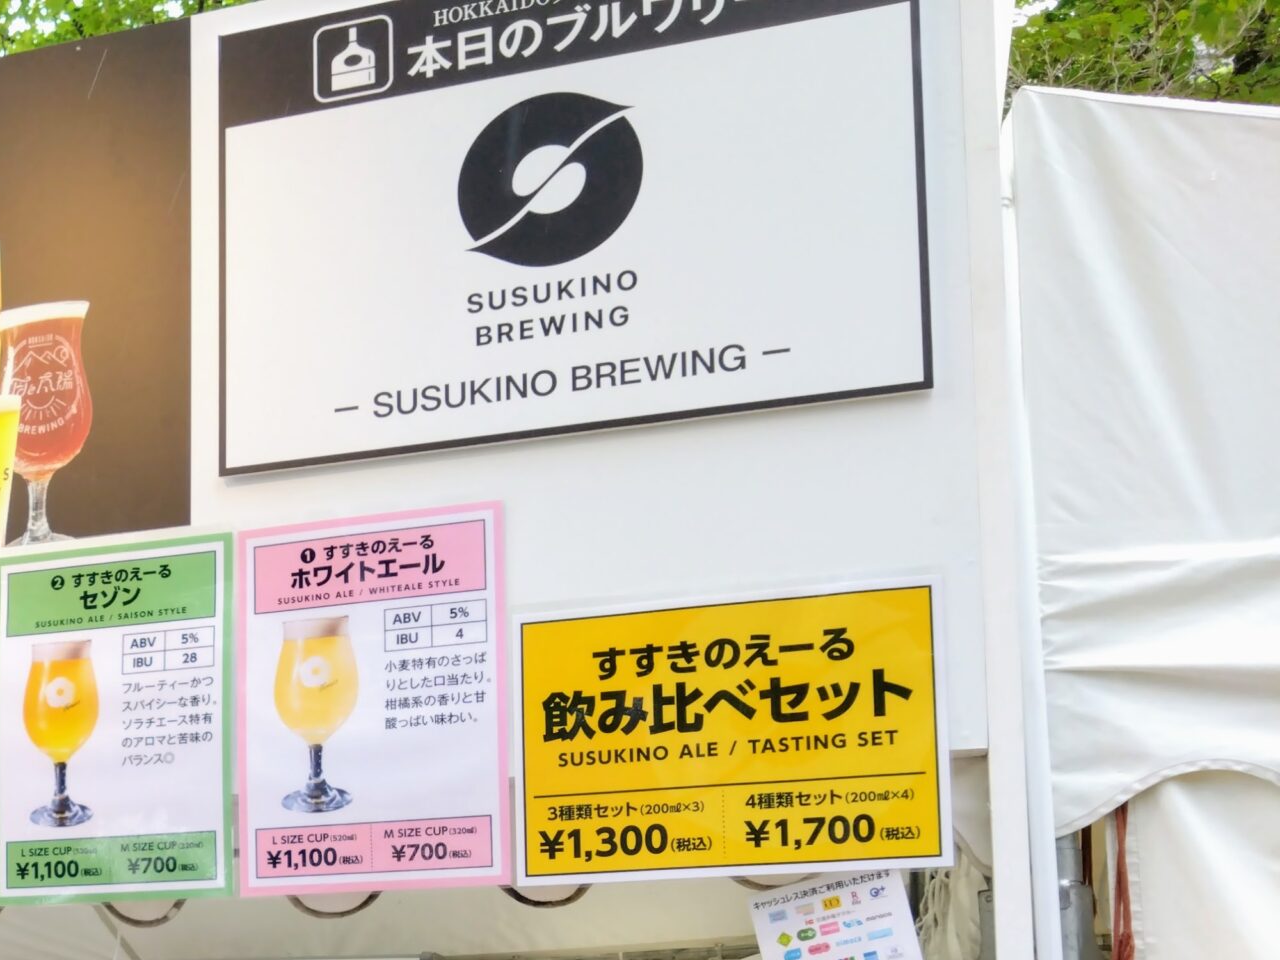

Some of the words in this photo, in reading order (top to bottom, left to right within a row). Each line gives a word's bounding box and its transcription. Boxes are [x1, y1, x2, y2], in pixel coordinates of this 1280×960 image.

[407, 0, 756, 79] 本日のブルワリ
[465, 268, 639, 315] SUSUKINO
[474, 305, 630, 347] BREWING
[371, 369, 557, 419] SUSUKINO
[571, 343, 746, 392] BREWING
[324, 535, 434, 560] すすきのえーる
[72, 564, 171, 587] すすきのえーる
[291, 553, 445, 589] ホワイトエール
[79, 586, 140, 611] セゾン
[278, 593, 330, 605] SUSUKINO
[335, 589, 354, 598] ALE
[368, 583, 423, 595] WHITEALE
[428, 578, 460, 588] STYLE
[35, 617, 83, 628] SUSUKINO
[88, 614, 105, 623] ALE
[118, 609, 153, 620] SAISON
[158, 606, 187, 616] STYLE
[392, 612, 421, 625] ABV
[449, 607, 469, 619] 5%
[130, 637, 156, 649] ABV
[181, 633, 199, 644] 5%
[396, 633, 418, 645] IBU
[455, 628, 464, 640] 4
[133, 657, 153, 668] IBU
[182, 652, 197, 664] 28
[385, 651, 486, 673] 小麦特有のさっぱ
[592, 627, 854, 680] すすきのえーる
[123, 676, 214, 693] フルーティーかつ
[385, 672, 491, 691] りとした口当たり。
[123, 695, 217, 712] スパイシーな香り。
[385, 691, 486, 710] 柑橘系の香りと甘
[542, 668, 913, 743] 飲み比べセット
[123, 712, 213, 730] ソラチエース特有
[385, 713, 479, 730] 酸っぱい味わい。
[122, 732, 212, 747] のアロマと苦味の
[558, 745, 668, 768] SUSUKINO
[679, 742, 718, 759] ALE
[748, 733, 847, 755] TASTING
[858, 730, 899, 747] SET
